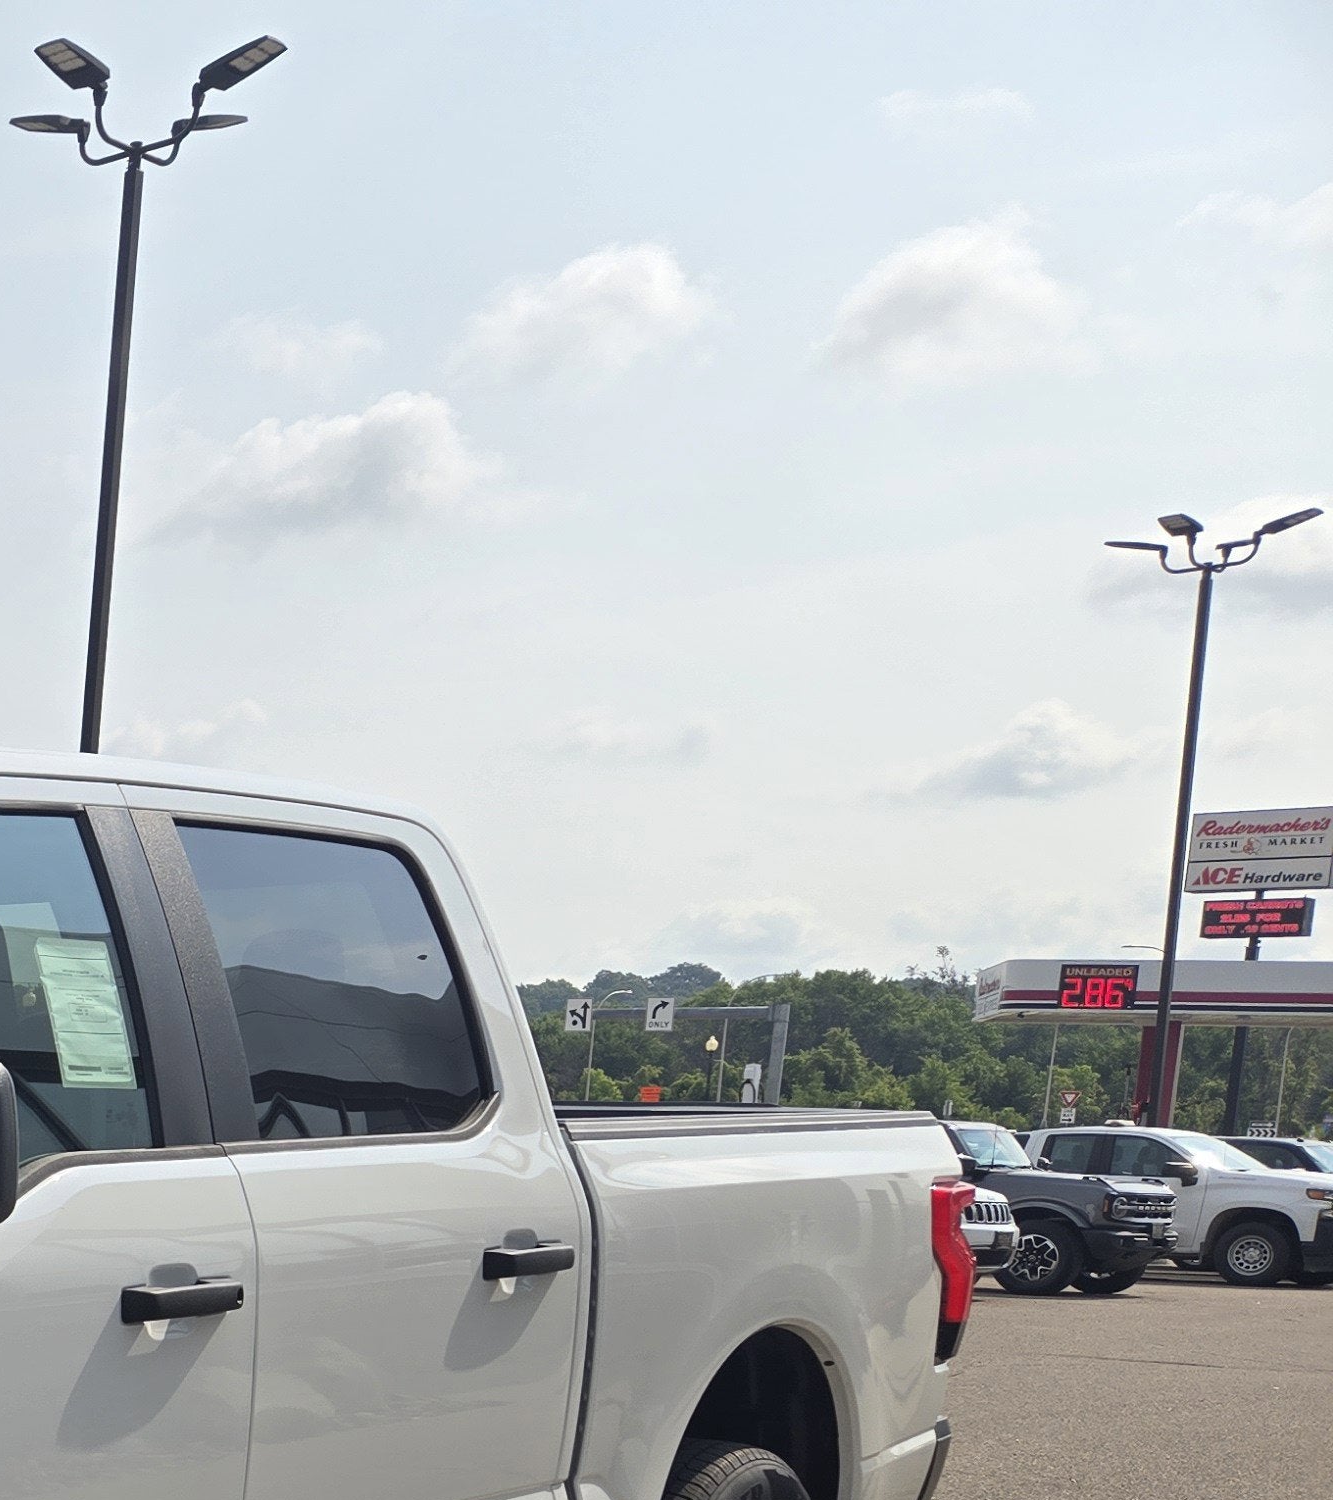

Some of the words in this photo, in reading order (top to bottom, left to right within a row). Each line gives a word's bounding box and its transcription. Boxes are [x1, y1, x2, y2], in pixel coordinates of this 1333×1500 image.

[1196, 817, 1332, 838] Radermacher's
[1199, 841, 1238, 849] FRESH
[1267, 836, 1324, 846] MARKET
[1192, 866, 1243, 886] ACE
[1242, 871, 1323, 884] Hardware
[1066, 967, 1133, 977] UNLEADED
[648, 1020, 670, 1029] ONLY
